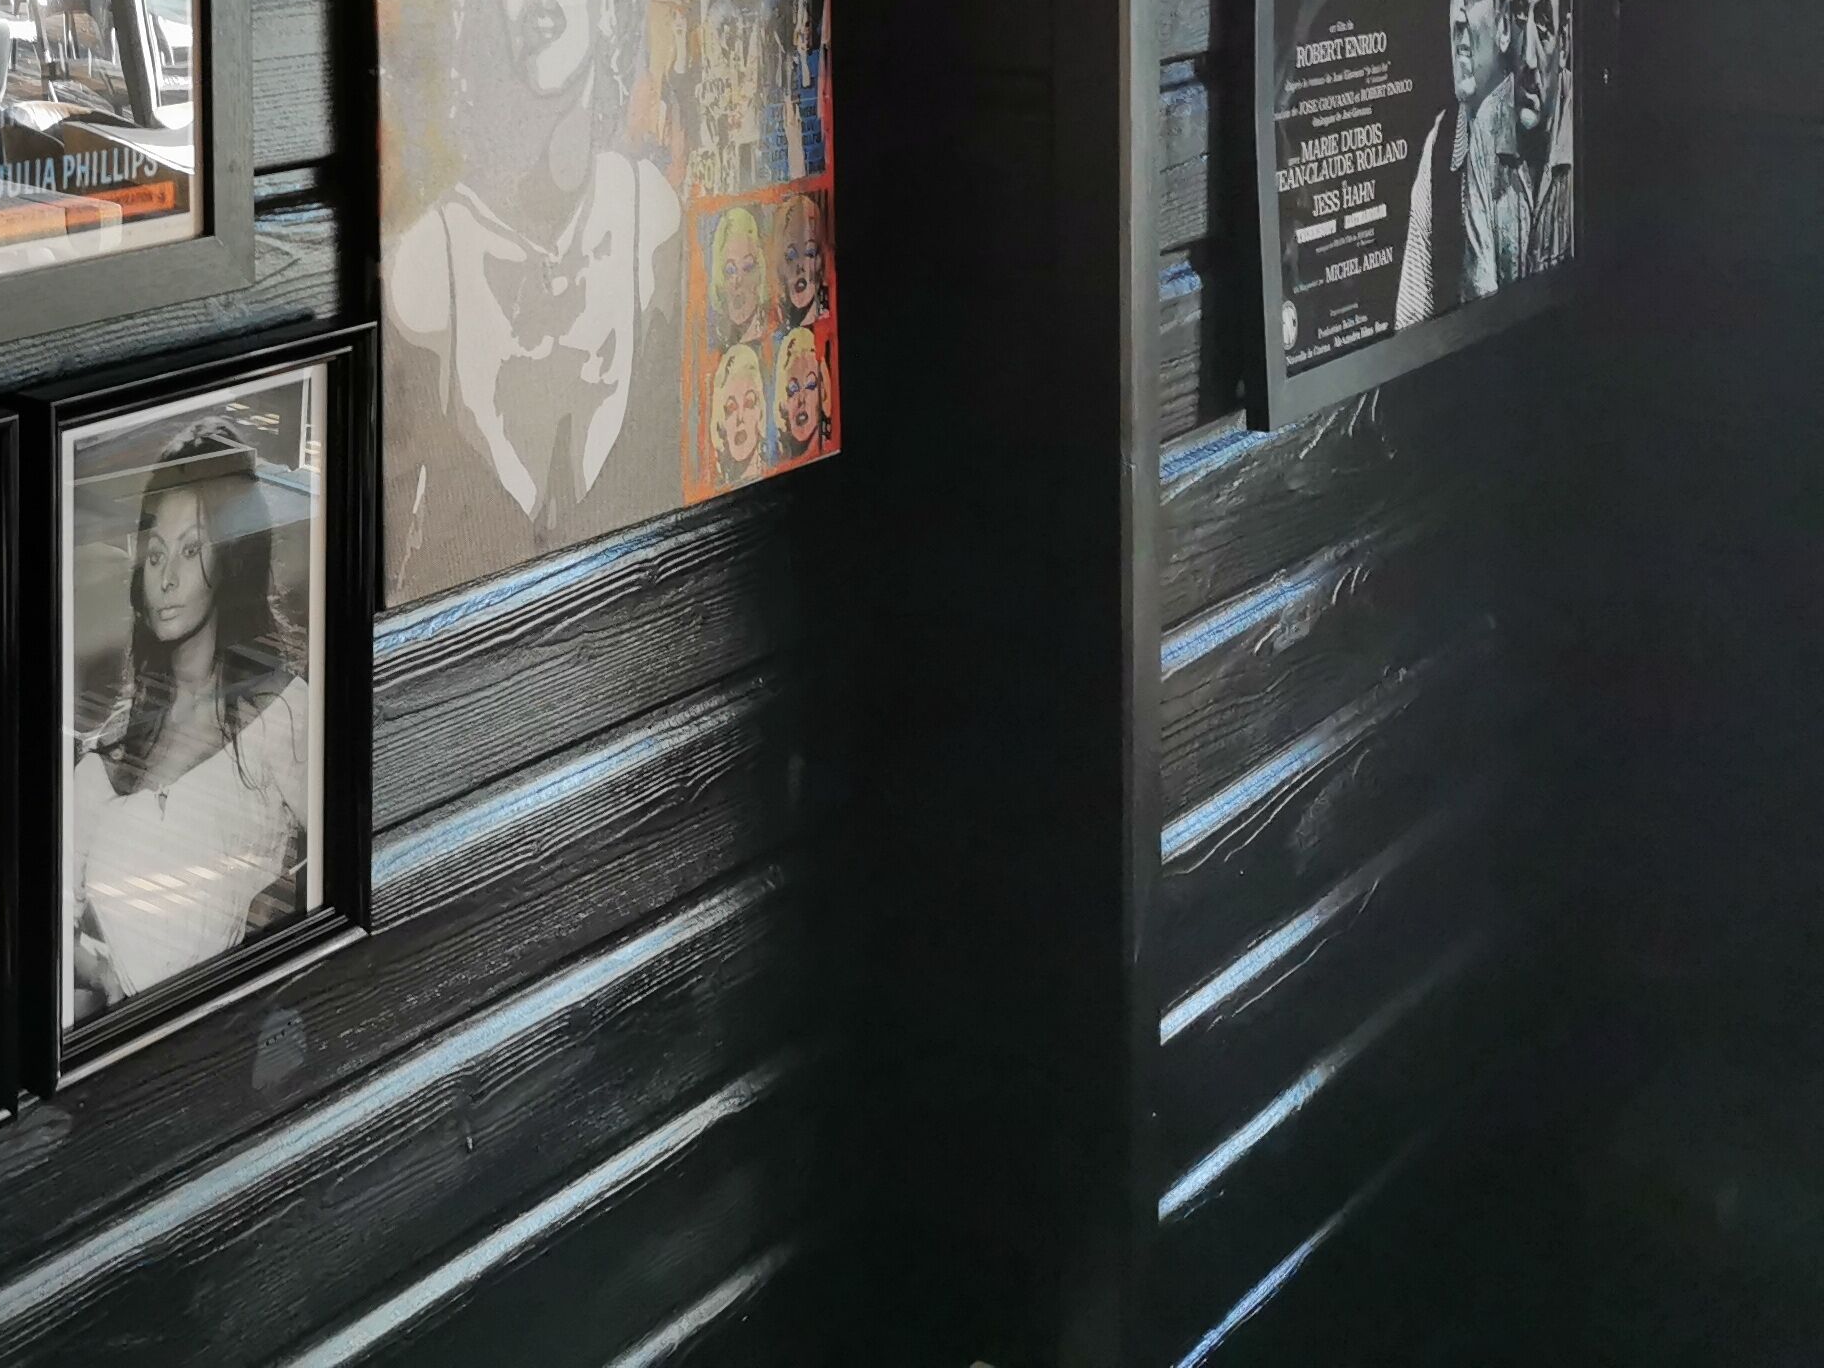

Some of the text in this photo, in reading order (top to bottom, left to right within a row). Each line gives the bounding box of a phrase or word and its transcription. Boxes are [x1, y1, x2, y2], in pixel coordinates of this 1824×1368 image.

[1295, 31, 1388, 69] ROBERT ENRICO
[1300, 122, 1383, 163] MARIE DUBOIS
[1355, 138, 1409, 172] ROLLAND
[62, 146, 159, 191] PHILLIPS
[1311, 190, 1341, 217] JESS
[1341, 179, 1377, 209] HAHN
[1324, 246, 1394, 284] MICHEL ARDAN
